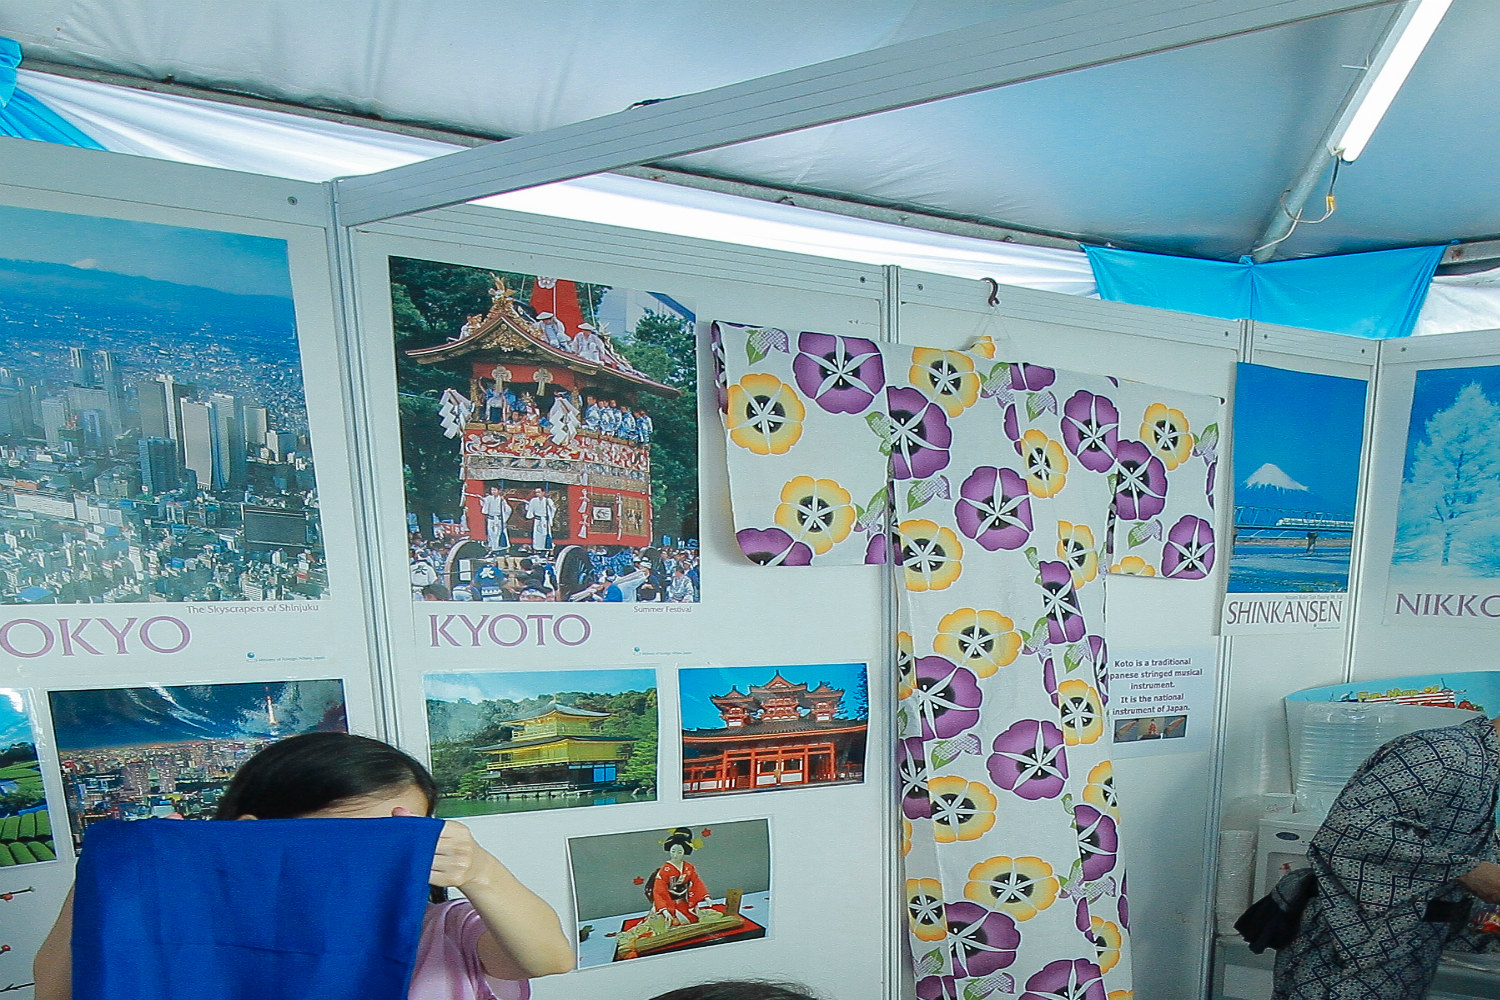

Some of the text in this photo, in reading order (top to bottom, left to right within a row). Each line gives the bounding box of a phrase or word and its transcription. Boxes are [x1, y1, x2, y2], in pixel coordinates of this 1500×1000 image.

[187, 603, 319, 614] The Skyscrapers of Shinjuku
[1227, 600, 1342, 624] SHINKANSEN
[429, 614, 591, 647] KYOTO
[0, 616, 190, 658] OKYO
[1115, 660, 1133, 668] Koto
[1152, 658, 1191, 666] traditional
[1109, 669, 1202, 680] panese stringed musical
[1131, 681, 1175, 690] instrument.
[1139, 694, 1151, 702] the
[1153, 693, 1184, 701] national
[1113, 707, 1155, 715] instrument
[1167, 704, 1190, 714] Japan.
